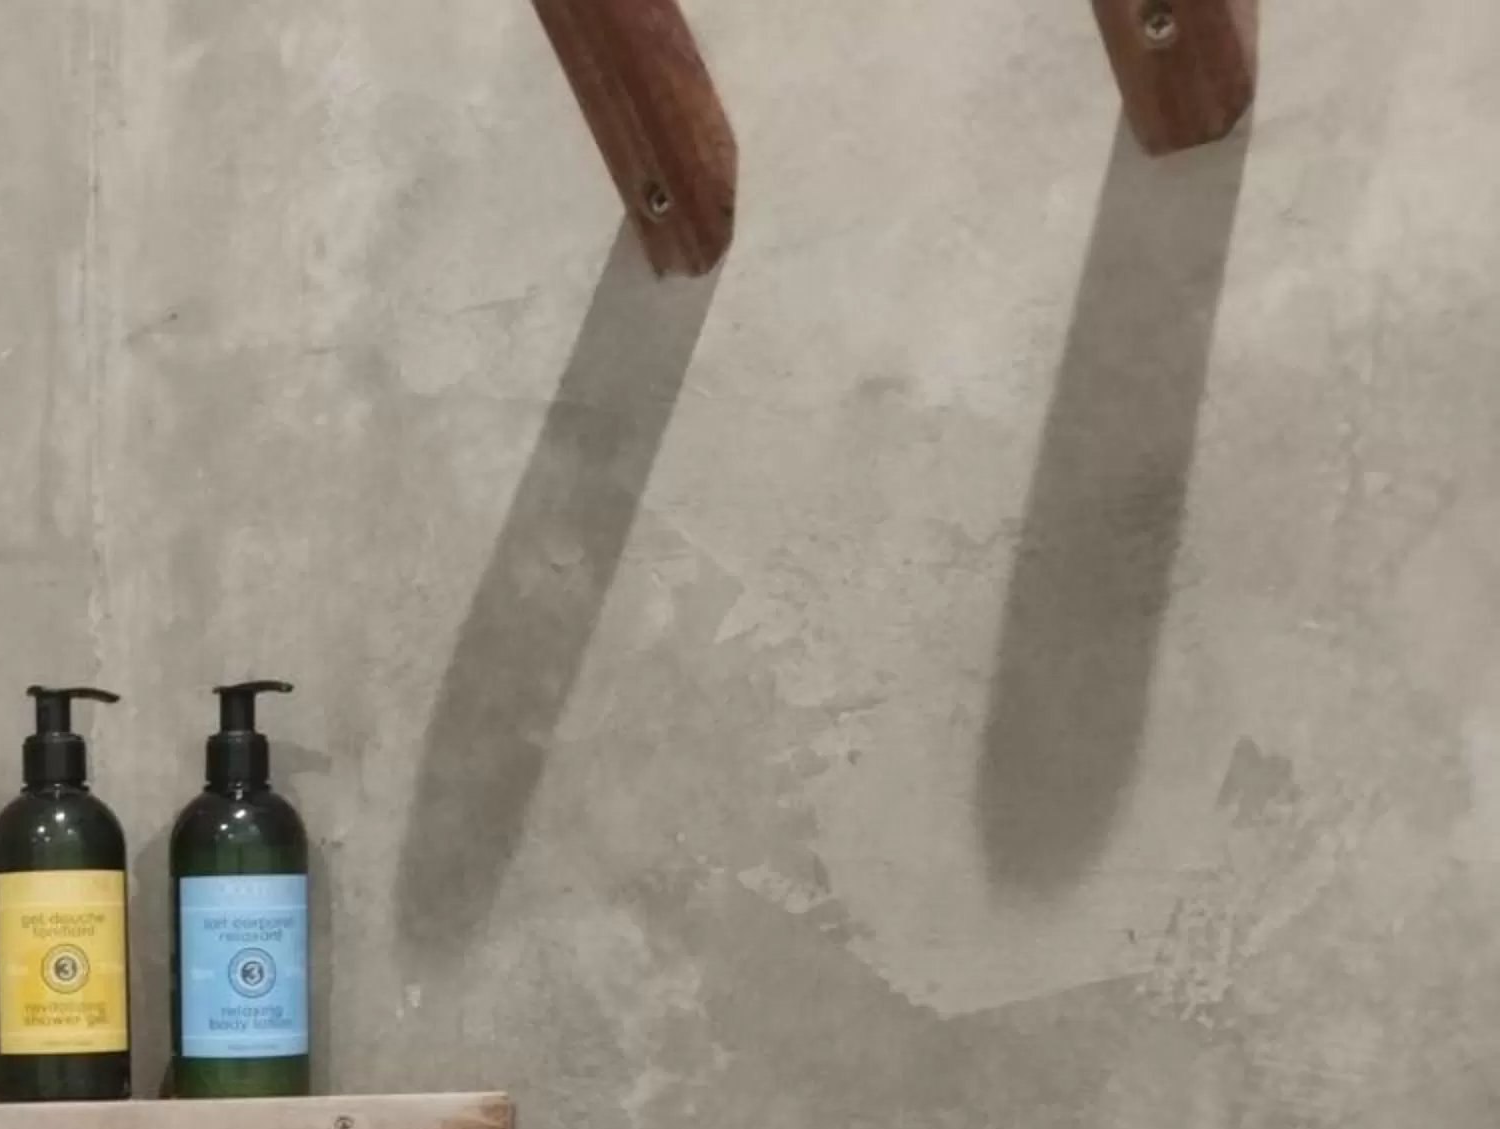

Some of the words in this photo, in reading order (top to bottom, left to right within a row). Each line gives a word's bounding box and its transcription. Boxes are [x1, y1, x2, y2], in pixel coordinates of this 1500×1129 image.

[21, 912, 45, 928] gel
[49, 911, 105, 925] douche
[221, 1005, 283, 1019] relaxing
[208, 1017, 247, 1031] body
